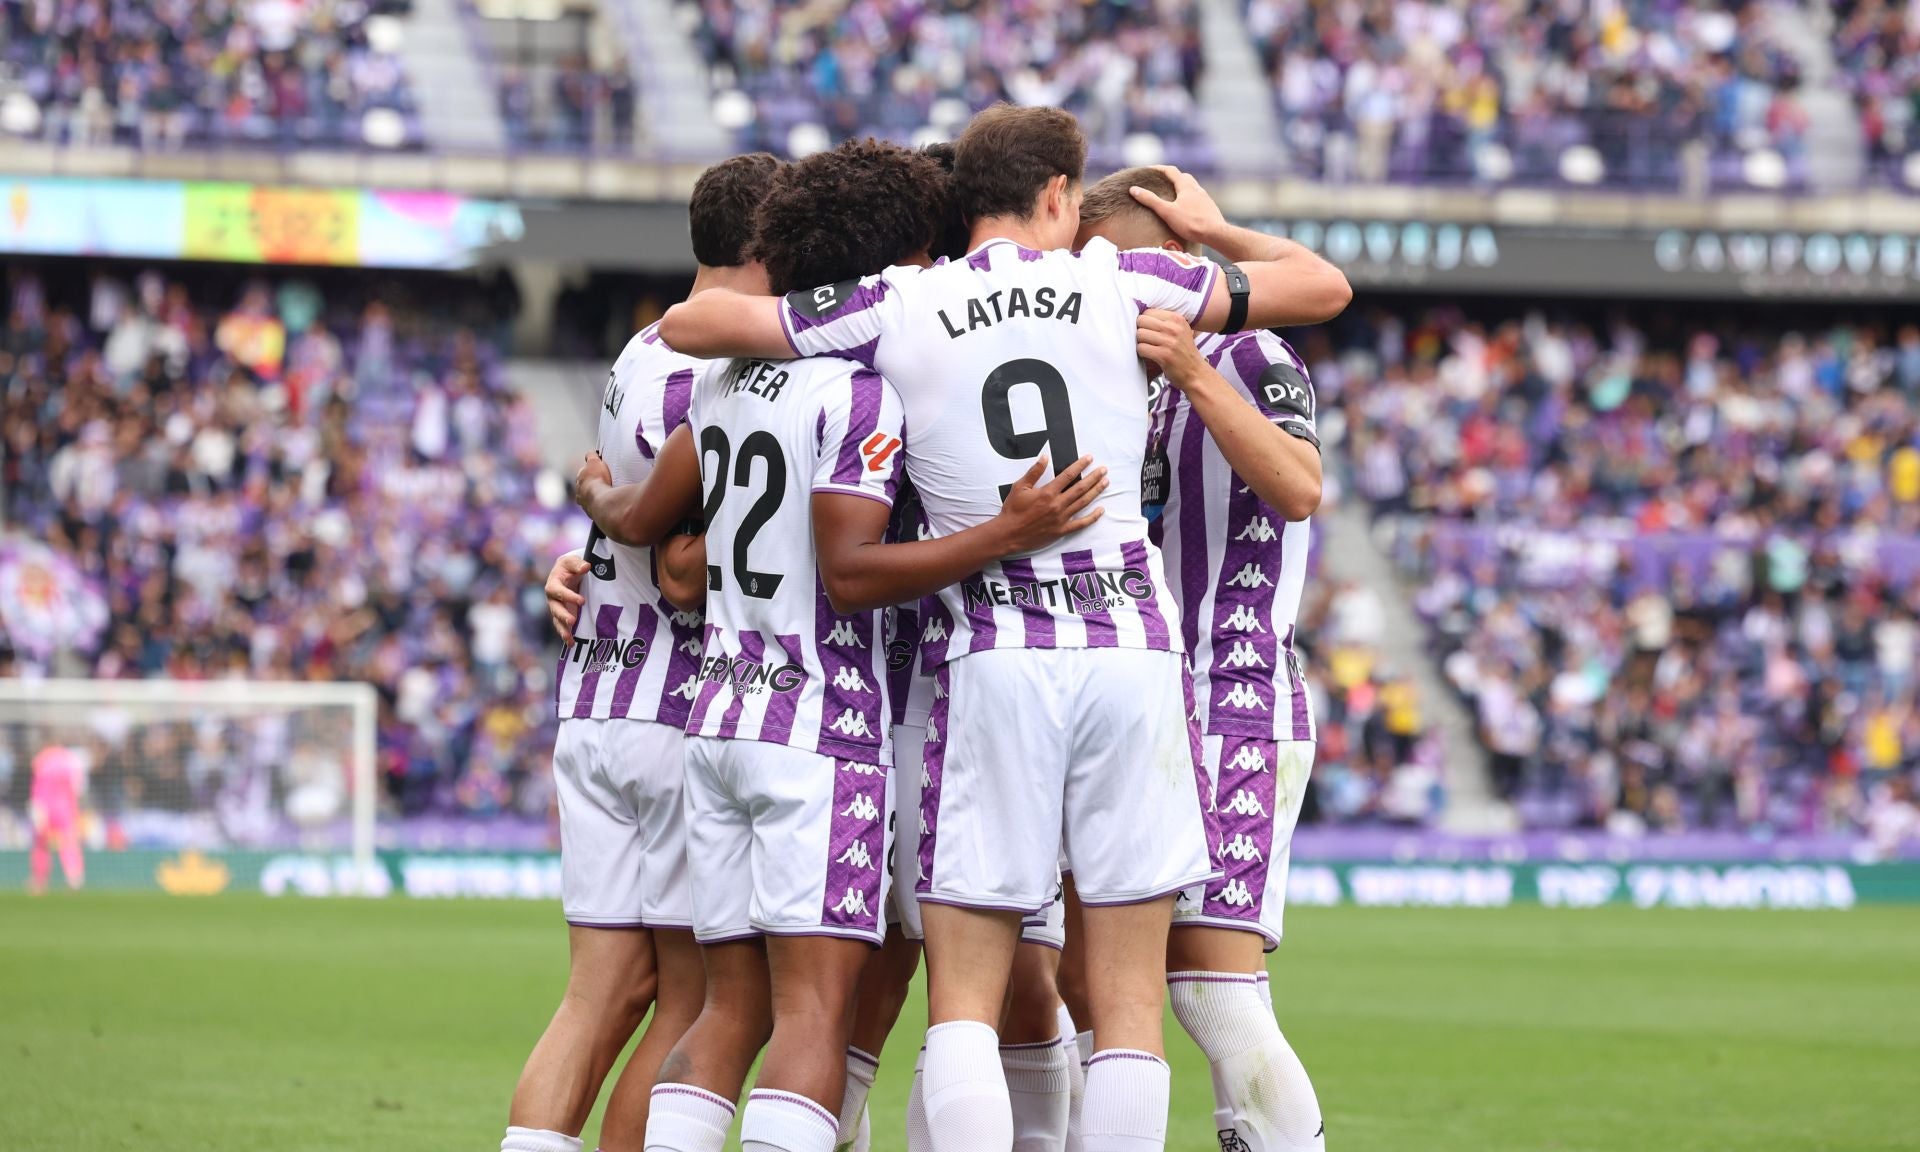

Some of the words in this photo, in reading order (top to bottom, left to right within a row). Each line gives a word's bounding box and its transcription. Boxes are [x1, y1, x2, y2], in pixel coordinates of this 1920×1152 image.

[937, 286, 1082, 339] LATASA
[981, 358, 1083, 512] 9
[700, 425, 787, 600] 22
[964, 568, 1151, 614] MERITKING
